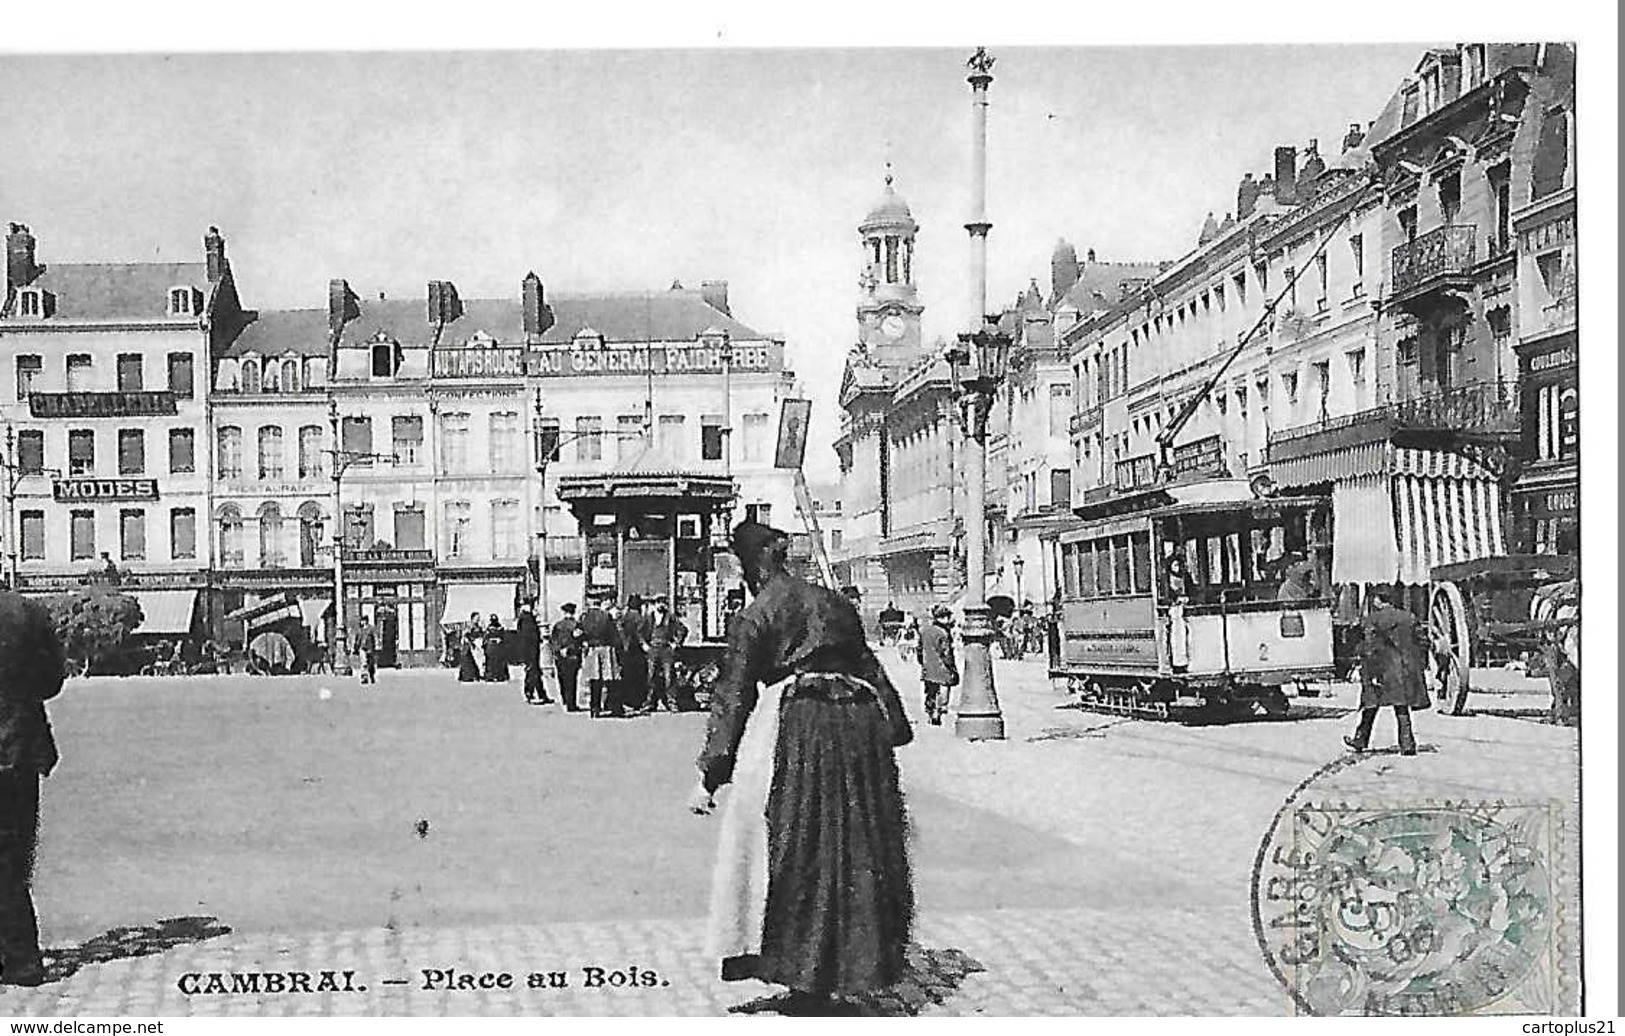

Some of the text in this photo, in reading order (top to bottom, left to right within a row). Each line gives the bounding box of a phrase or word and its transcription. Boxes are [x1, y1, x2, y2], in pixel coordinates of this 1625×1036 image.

[484, 349, 523, 375] ROUGE
[539, 348, 770, 372] AU GENERAL FAIDHRBE
[58, 481, 153, 498] MODES
[1259, 642, 1269, 661] 2
